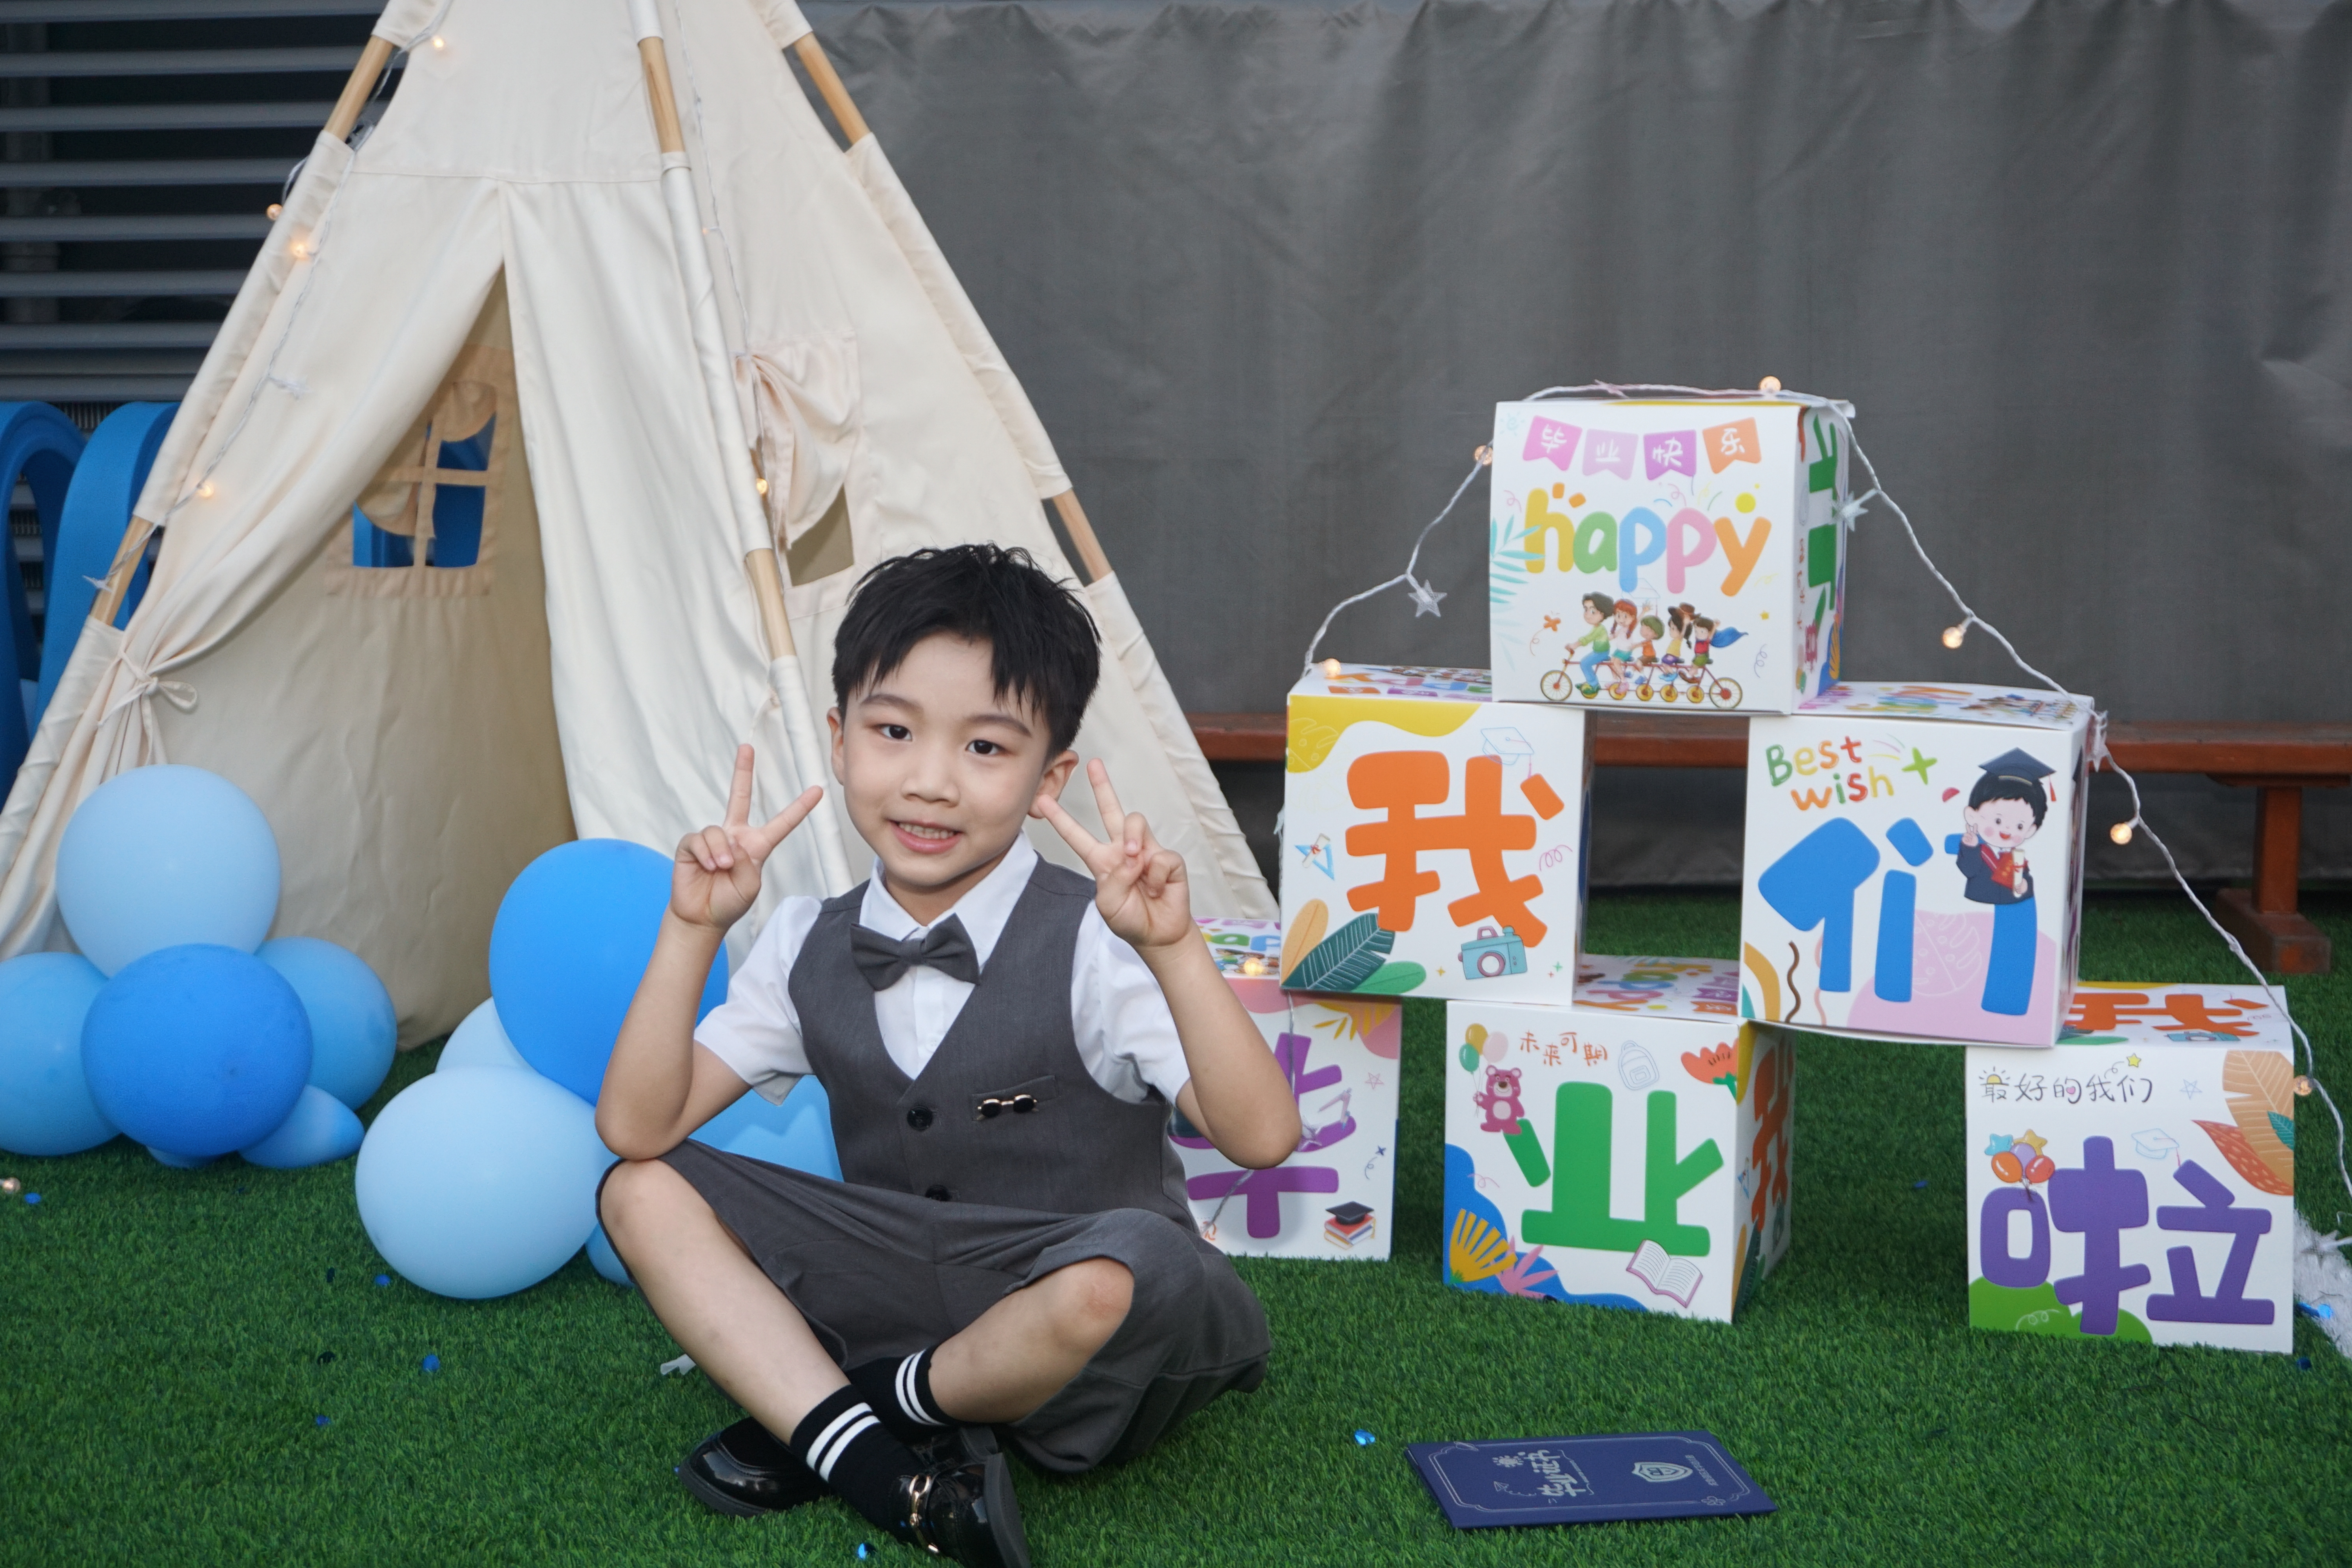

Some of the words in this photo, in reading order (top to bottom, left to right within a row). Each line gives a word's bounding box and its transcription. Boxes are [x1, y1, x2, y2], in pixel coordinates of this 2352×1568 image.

[1541, 425, 1745, 467] 毕业快乐
[1523, 488, 1772, 597] happy
[1766, 736, 1862, 786] Best
[1791, 765, 1894, 811] wish
[1345, 750, 1565, 948] 我
[1757, 817, 2038, 1016] 们
[1520, 1029, 1608, 1067] 未来可期
[1978, 1073, 2153, 1103] 最好的我们
[1503, 1081, 1724, 1257] 业
[1980, 1135, 2275, 1335] 啦
[1517, 1449, 1586, 1497] 毕业证书
